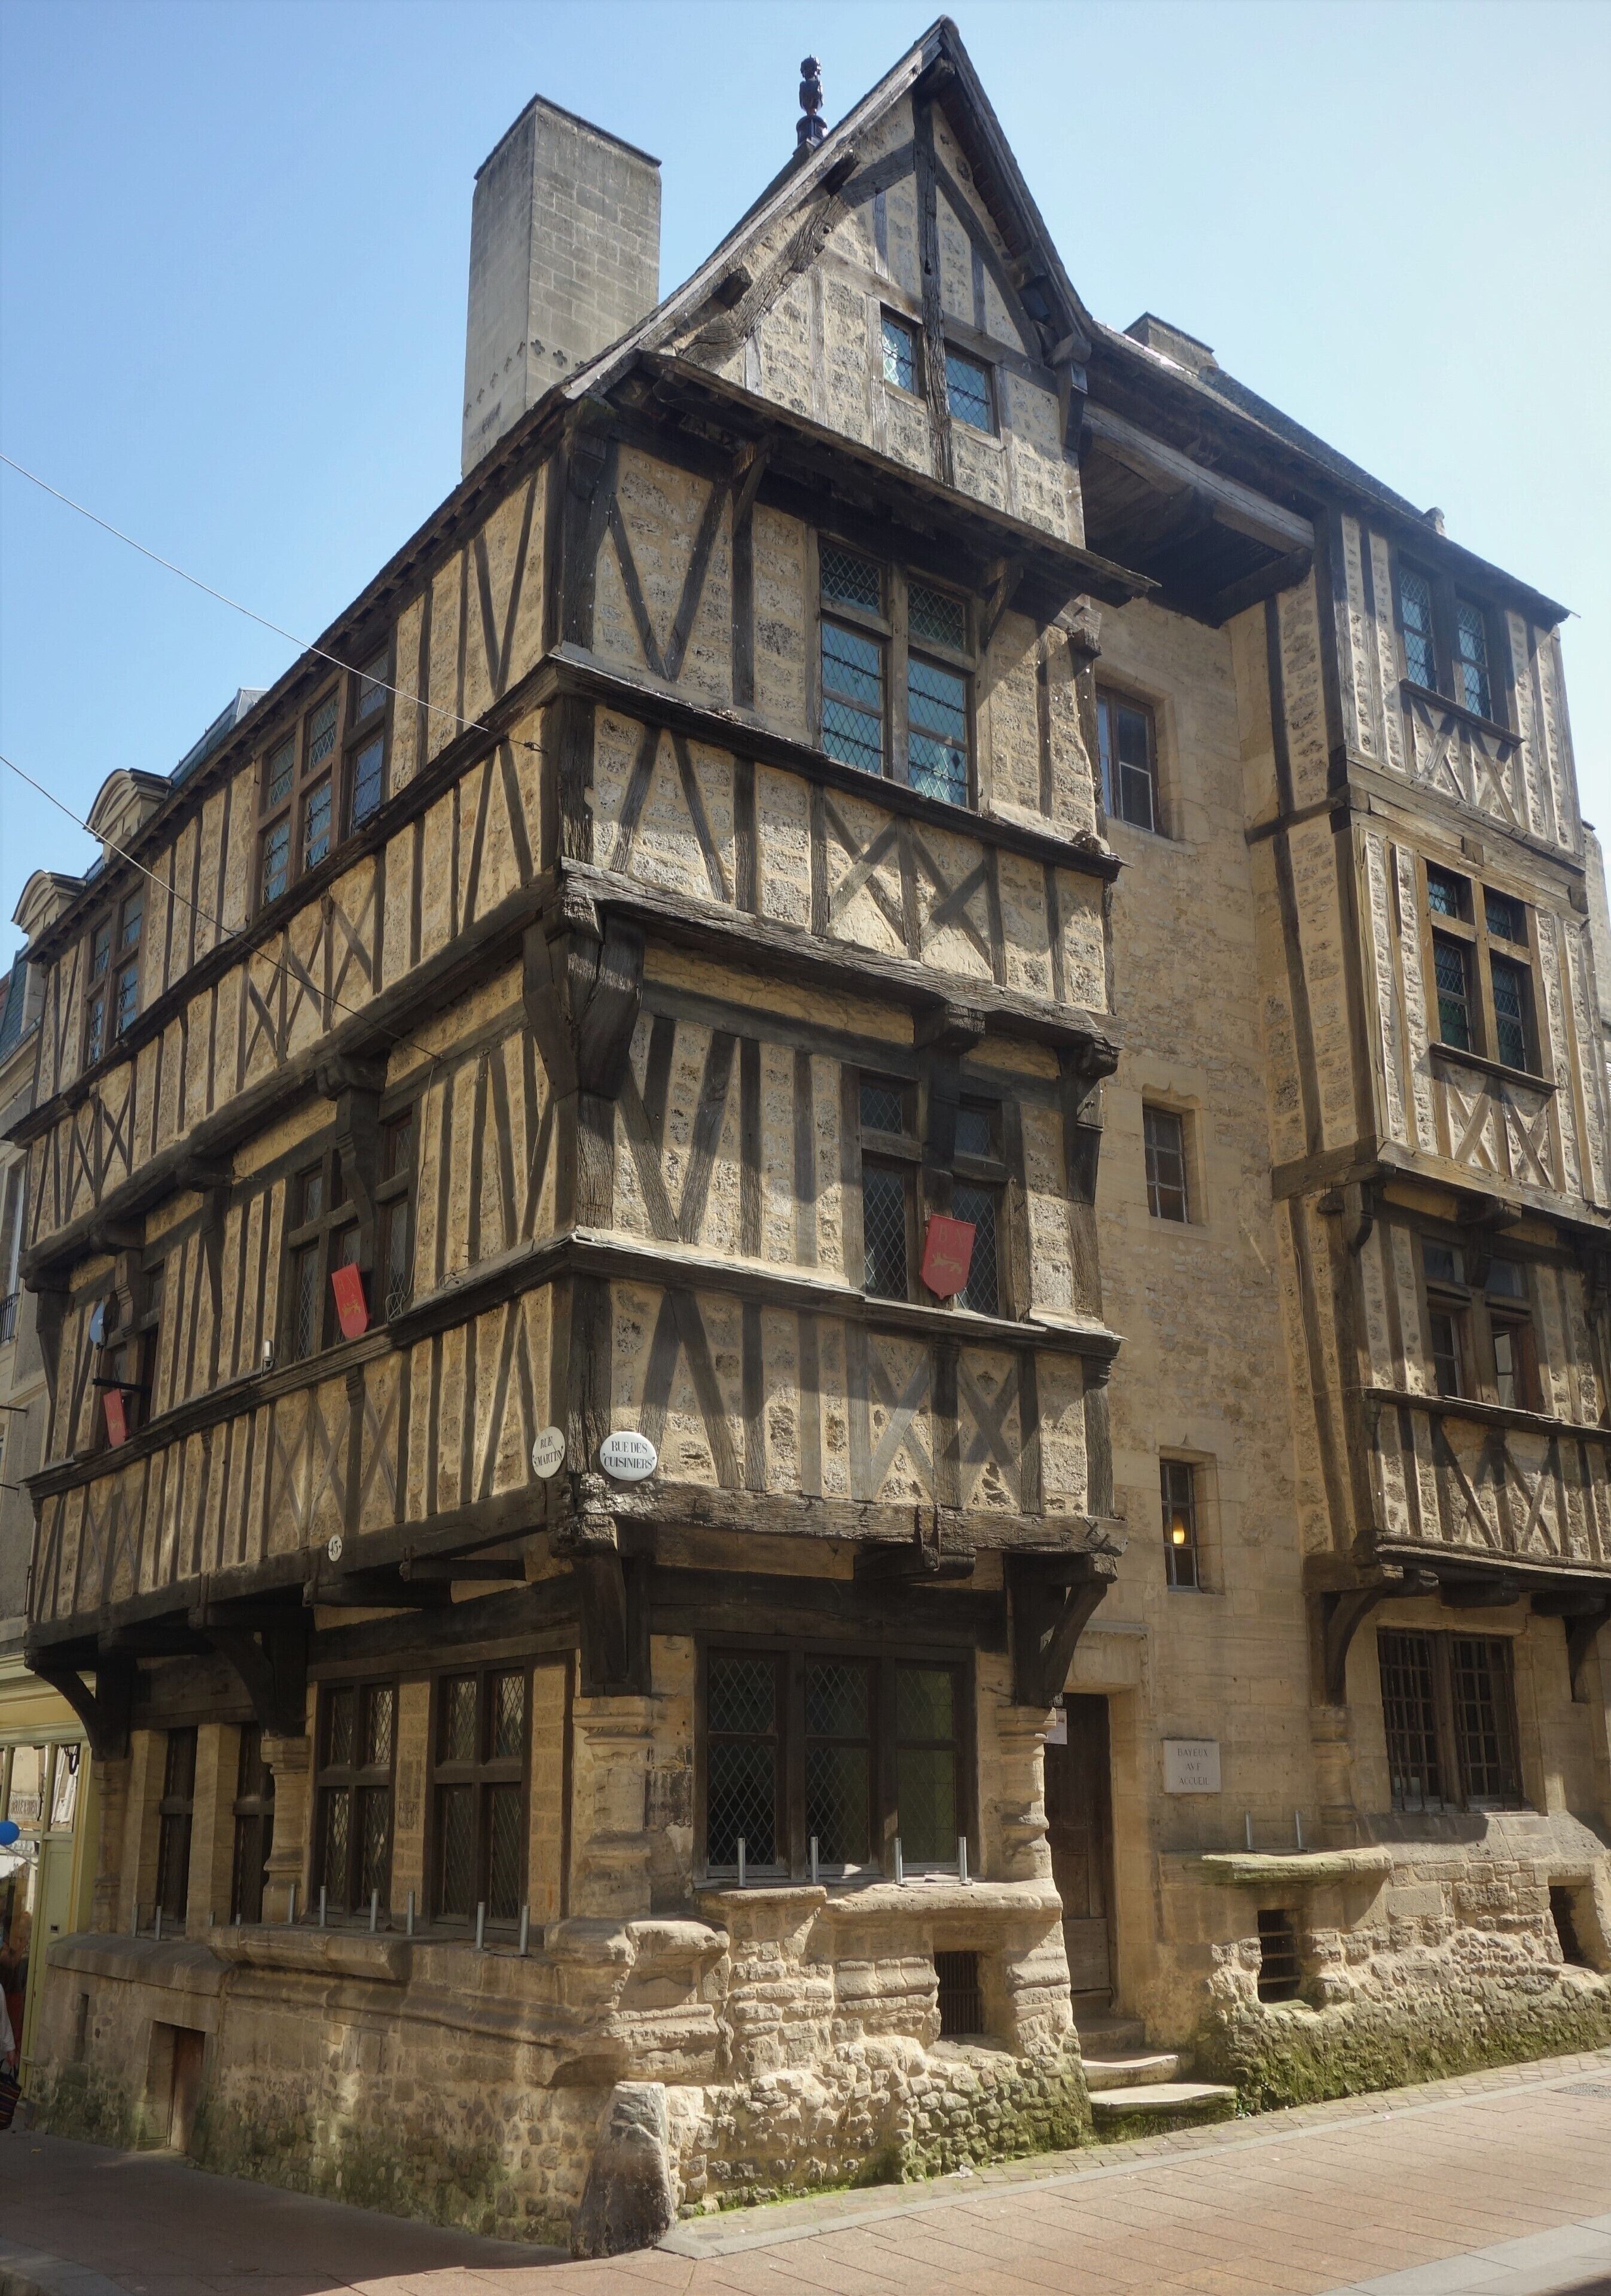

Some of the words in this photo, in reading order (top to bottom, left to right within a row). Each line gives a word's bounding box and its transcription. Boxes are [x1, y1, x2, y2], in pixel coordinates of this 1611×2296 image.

[540, 1436, 553, 1449] RUE
[611, 1440, 629, 1453] RUE
[630, 1442, 648, 1454] DES
[604, 1456, 652, 1469] CUISINIERS
[1177, 1748, 1209, 1757] BAYEUX
[1179, 1776, 1209, 1785] ACCUEIL
